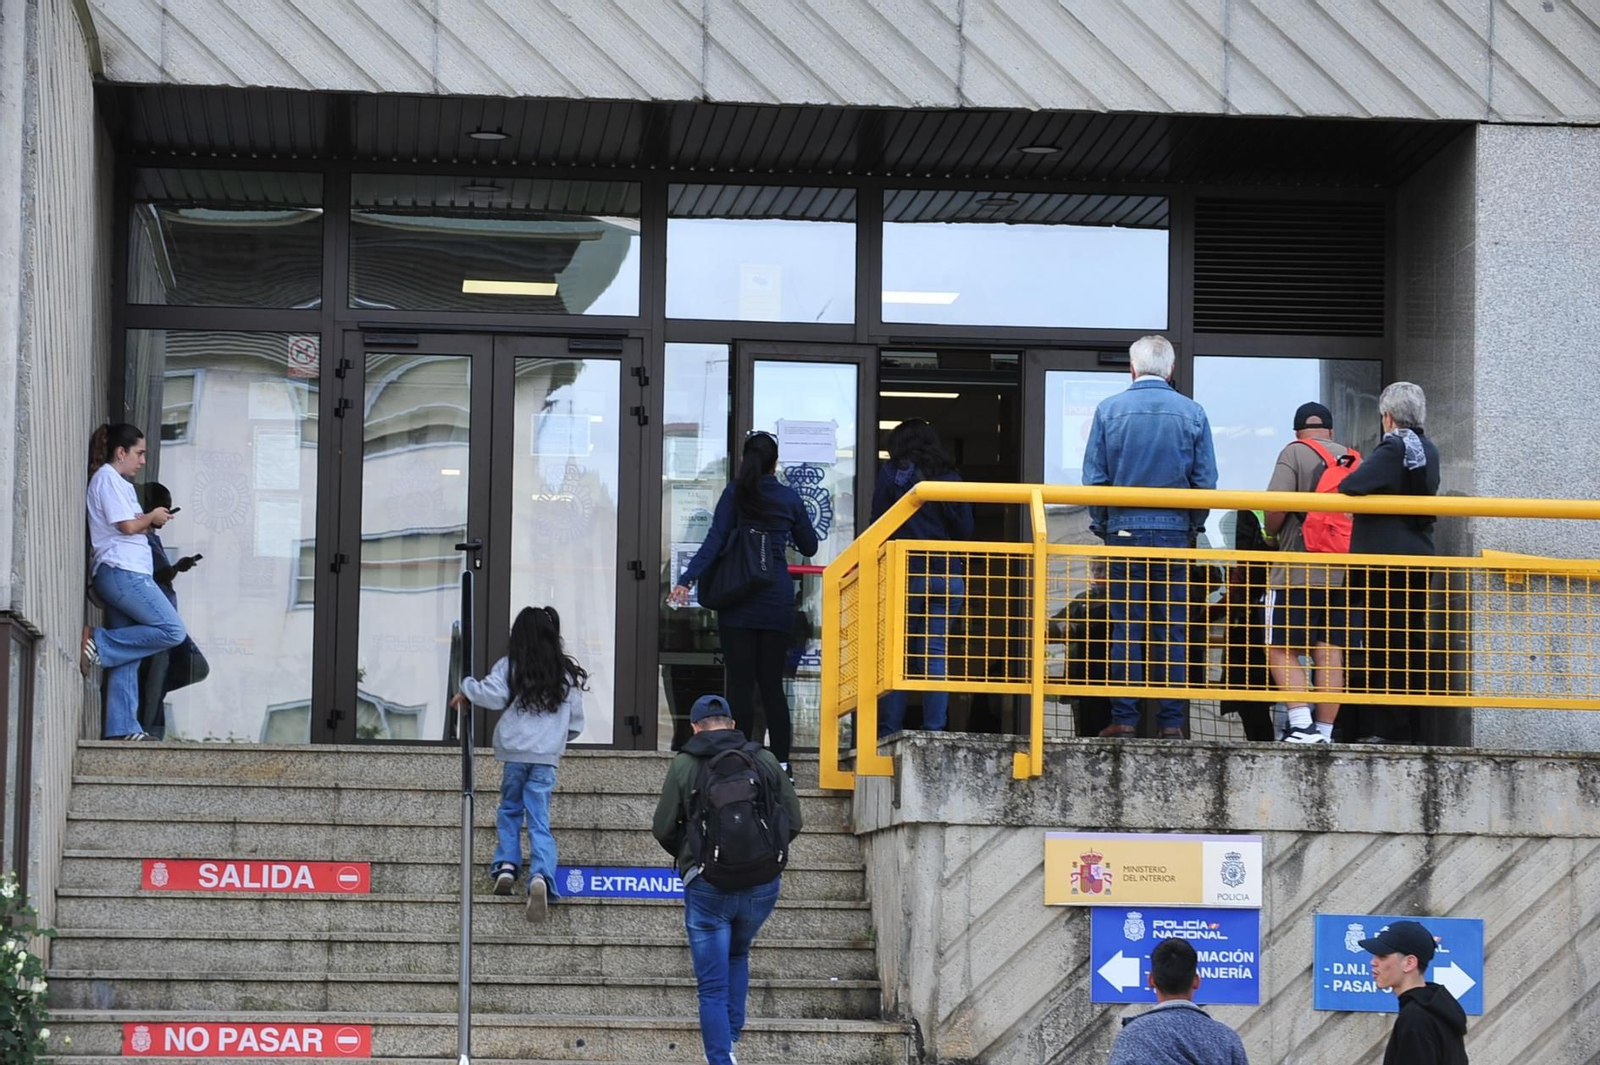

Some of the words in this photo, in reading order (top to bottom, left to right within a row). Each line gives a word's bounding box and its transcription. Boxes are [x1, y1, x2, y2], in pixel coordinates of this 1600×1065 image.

[198, 863, 315, 888] SALIDA
[1122, 865, 1168, 873] MINISTERIO
[590, 876, 685, 892] EXTRANJE
[1139, 874, 1177, 882] INTERIOR
[1216, 892, 1250, 901] POLICIA
[1152, 930, 1229, 940] NACIONAL
[1196, 948, 1254, 963] MACIÓN
[1333, 962, 1370, 976] D.N.I.
[164, 1027, 210, 1052] NO
[218, 1028, 323, 1053] PASAR
